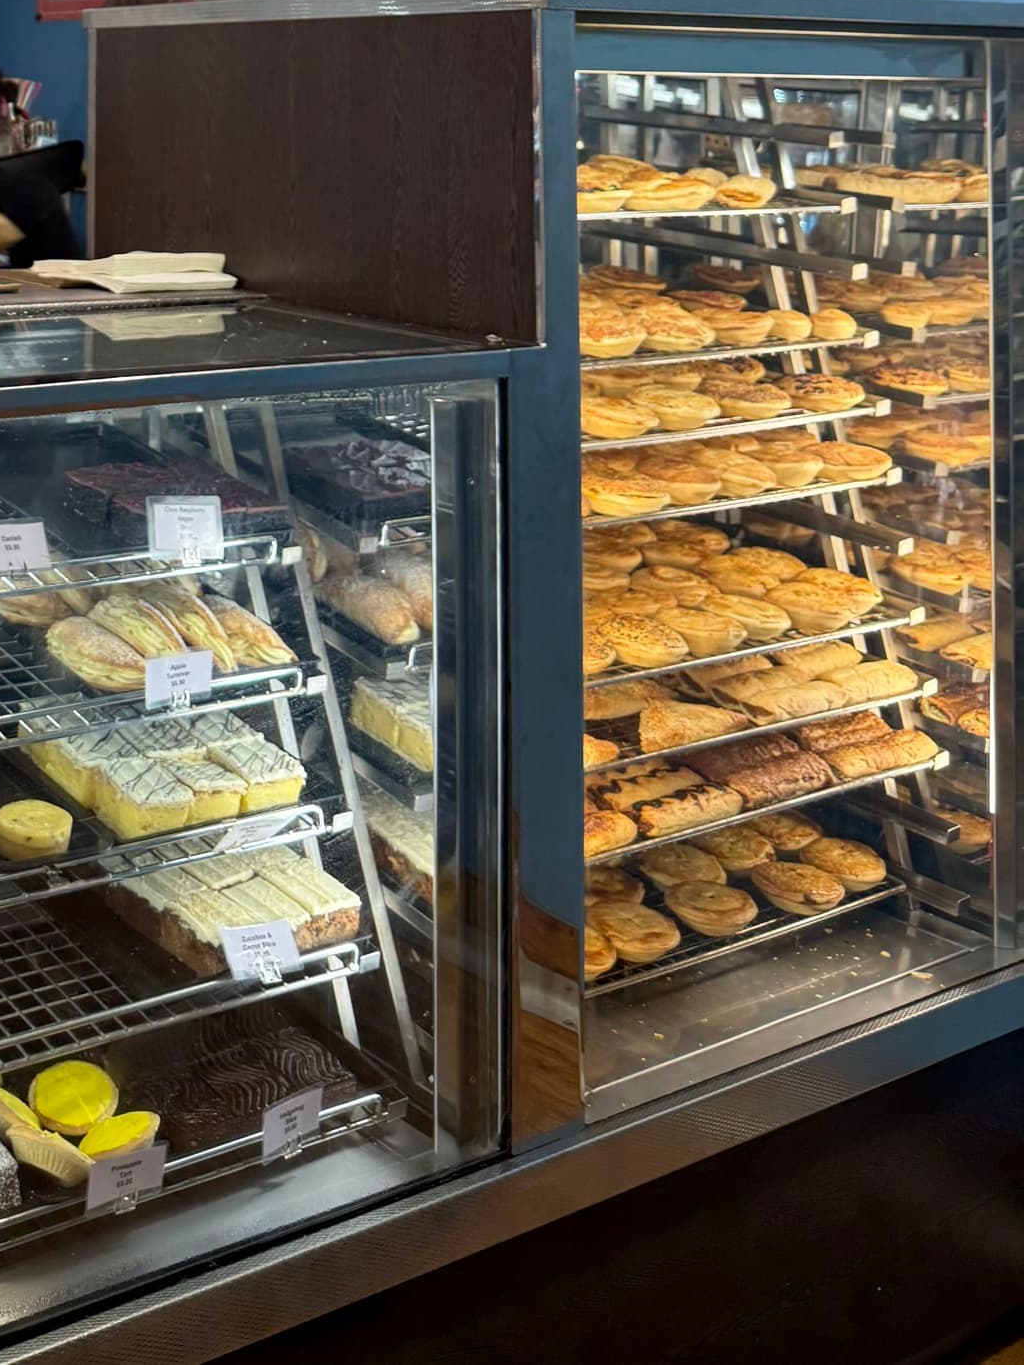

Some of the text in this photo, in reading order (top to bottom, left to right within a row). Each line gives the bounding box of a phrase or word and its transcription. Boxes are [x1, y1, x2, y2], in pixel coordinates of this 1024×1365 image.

[170, 662, 187, 671] Apple
[166, 670, 191, 680] Turnover
[120, 1169, 133, 1179] Tart
